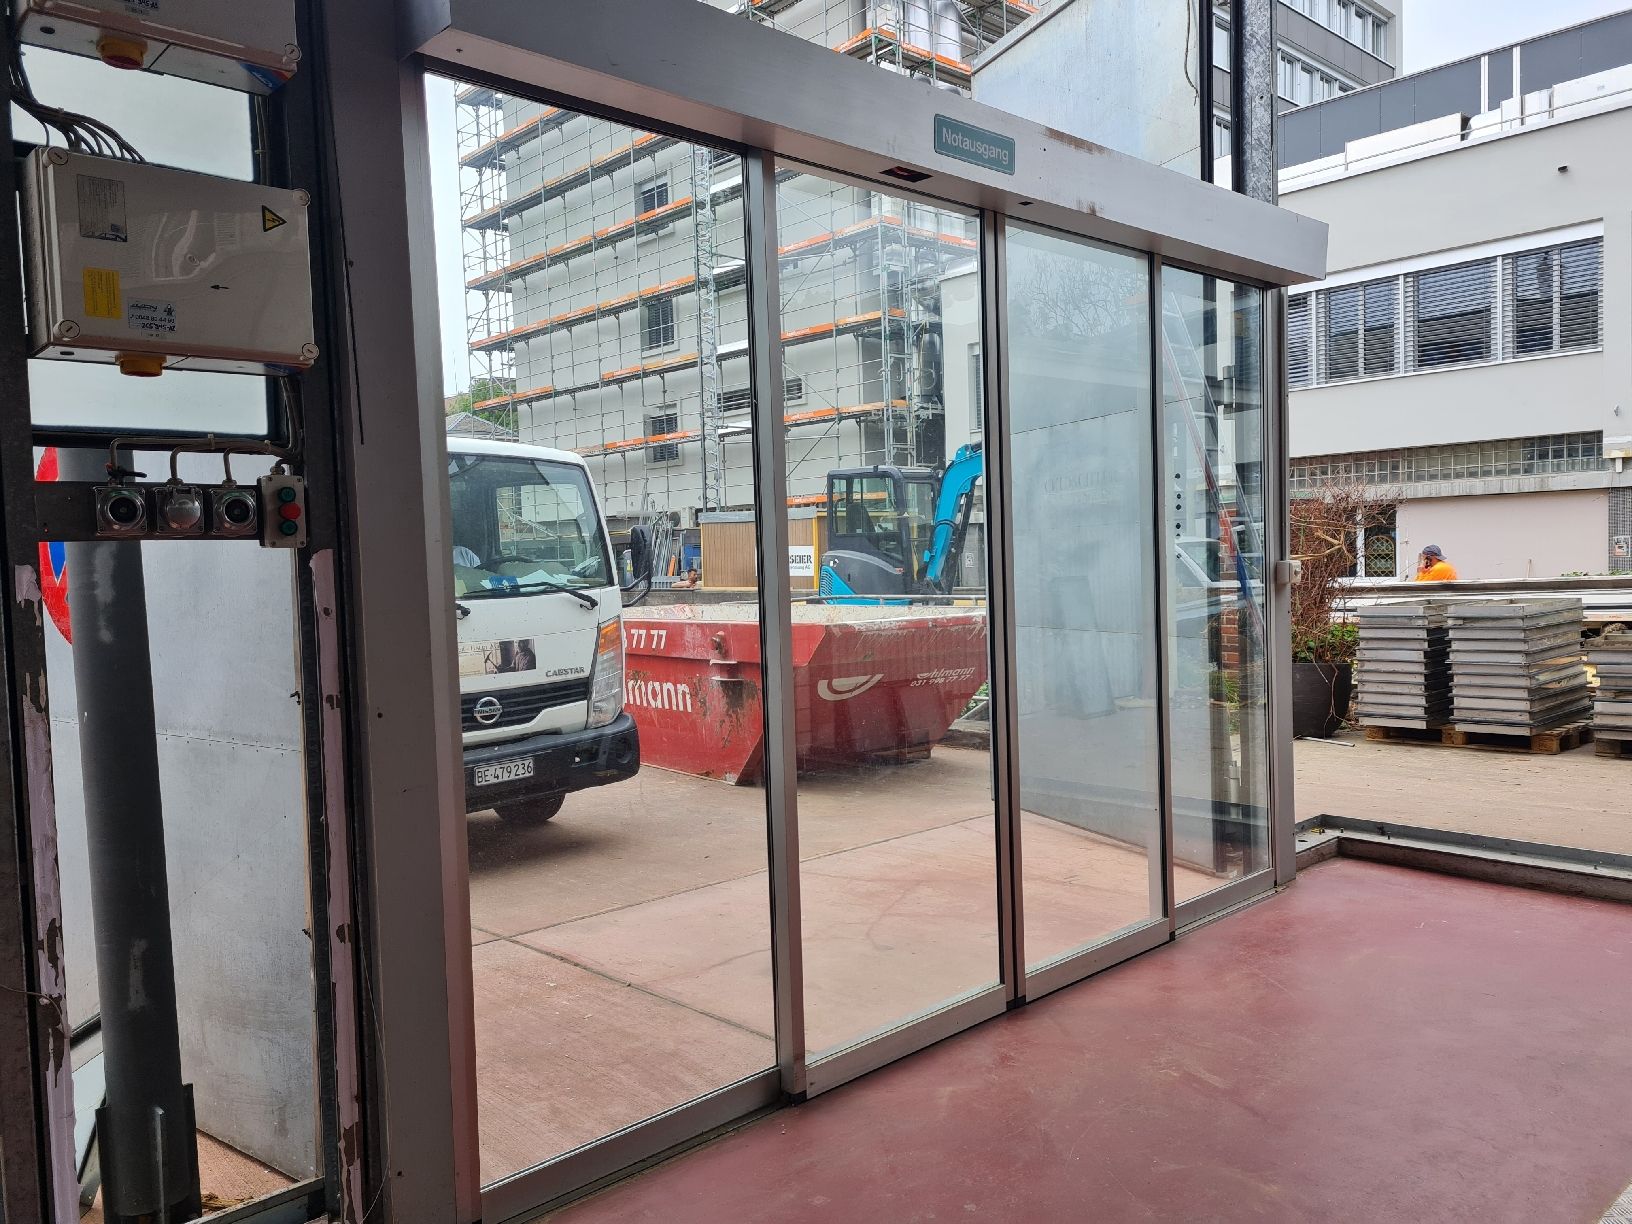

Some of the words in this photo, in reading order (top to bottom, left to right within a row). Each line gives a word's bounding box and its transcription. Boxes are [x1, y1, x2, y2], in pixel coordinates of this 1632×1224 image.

[942, 127, 1009, 165] Notausgang
[630, 628, 647, 649] 77
[650, 629, 667, 650] 77
[545, 666, 585, 678] CABSTAR
[625, 679, 692, 713] mann
[477, 706, 502, 715] NISSAN
